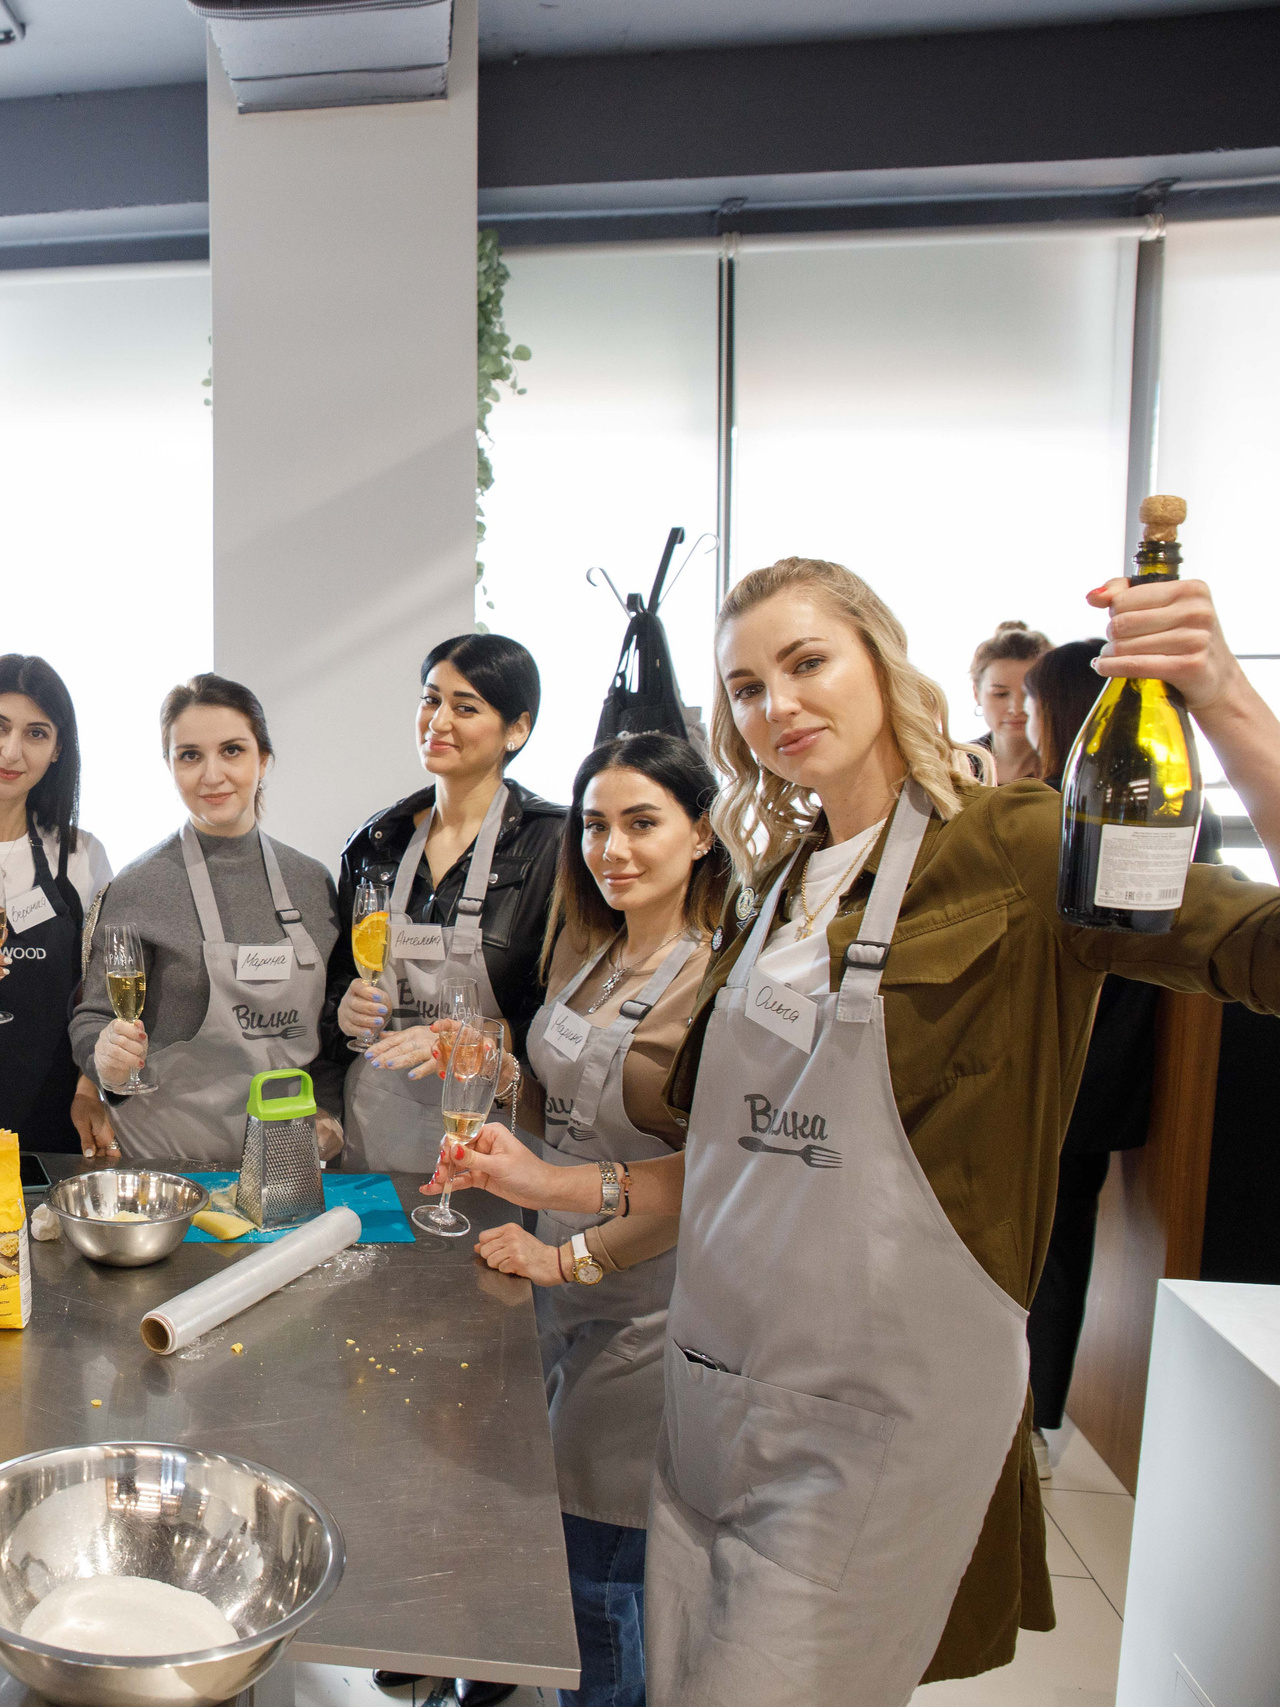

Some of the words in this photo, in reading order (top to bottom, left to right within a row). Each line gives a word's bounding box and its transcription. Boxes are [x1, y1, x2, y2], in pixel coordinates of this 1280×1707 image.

[0, 946, 47, 960] WOOD
[241, 952, 287, 971] Марина
[754, 985, 800, 1024] Ольга
[232, 1004, 300, 1030] Вилка
